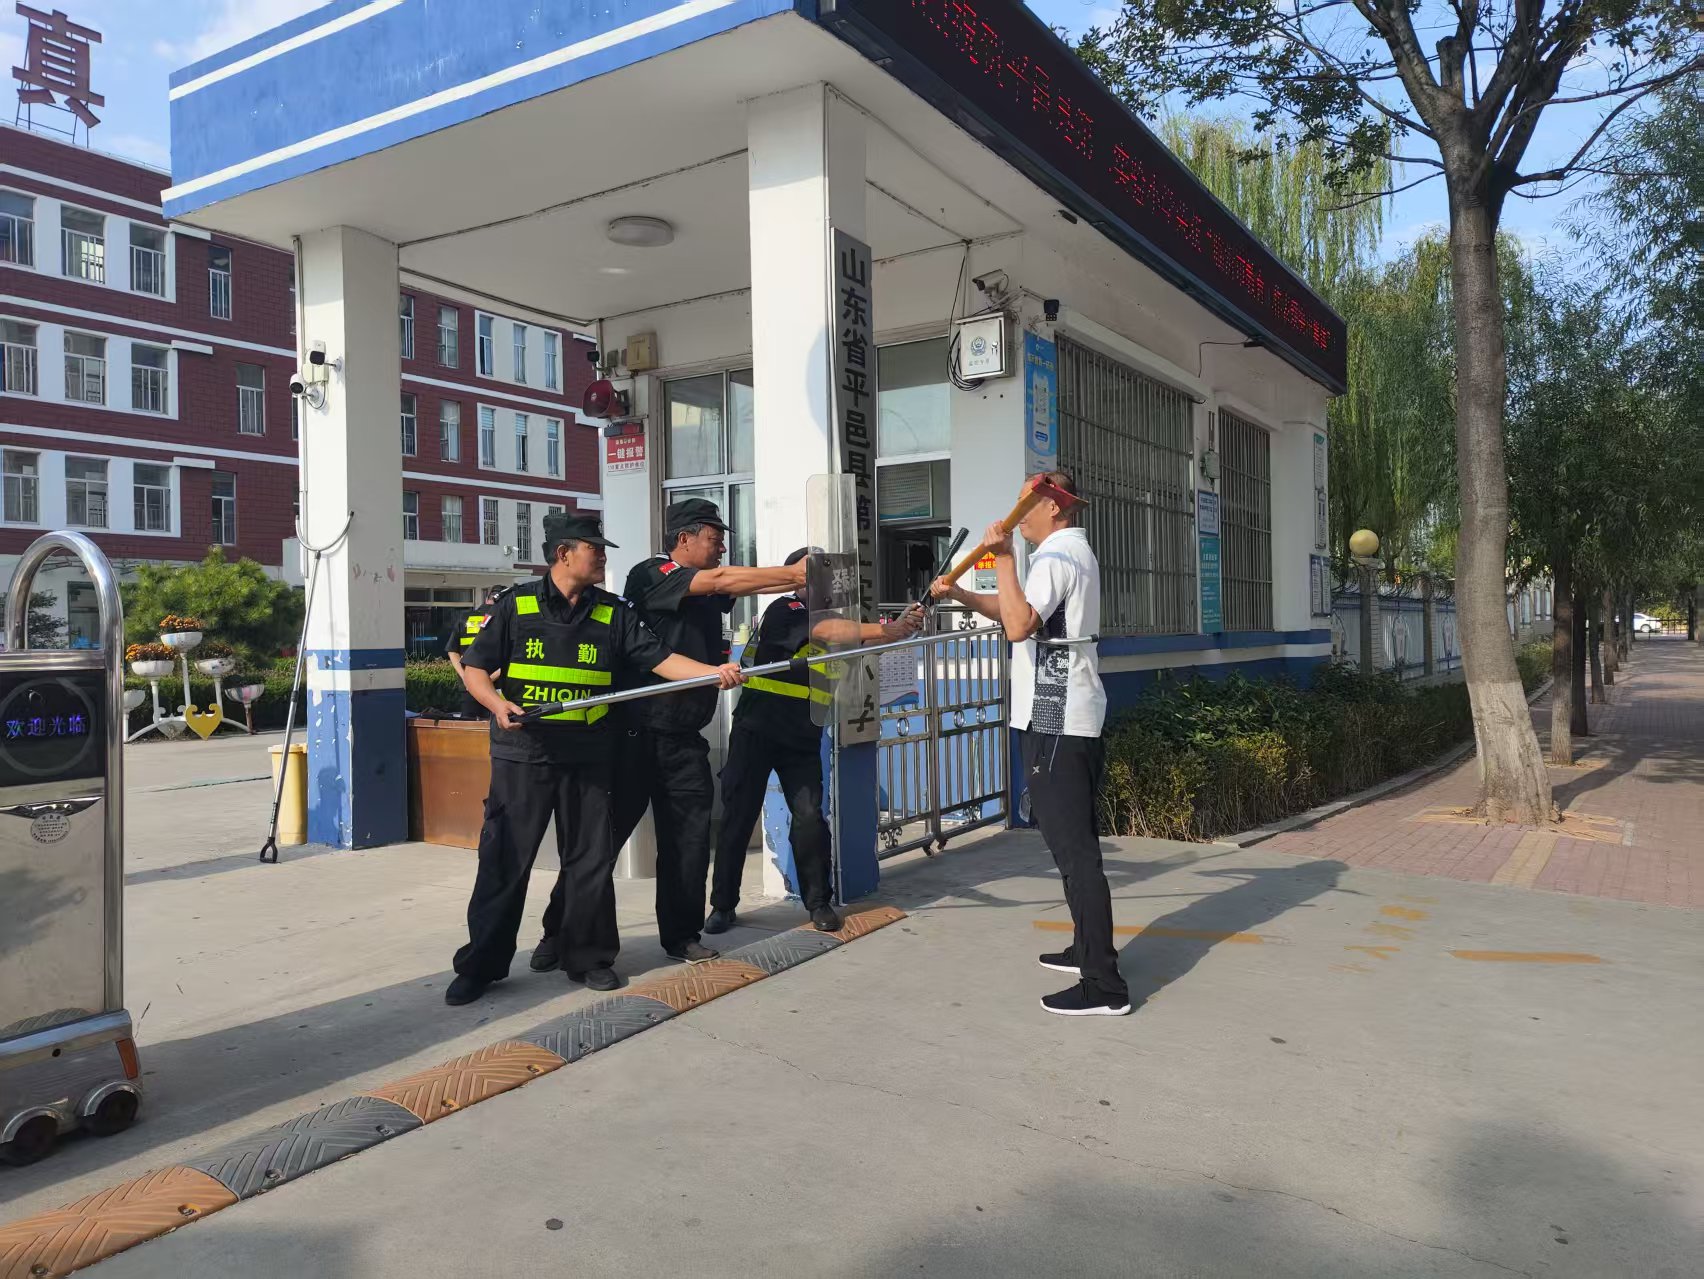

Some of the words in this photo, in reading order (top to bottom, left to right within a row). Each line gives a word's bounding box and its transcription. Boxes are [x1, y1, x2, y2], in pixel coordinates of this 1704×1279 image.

[11, 3, 104, 128] 真
[608, 446, 644, 459] 一键报警
[525, 638, 598, 665] 执勤
[522, 684, 591, 703] ZHIQIN
[6, 713, 86, 739] 欢迎光临
